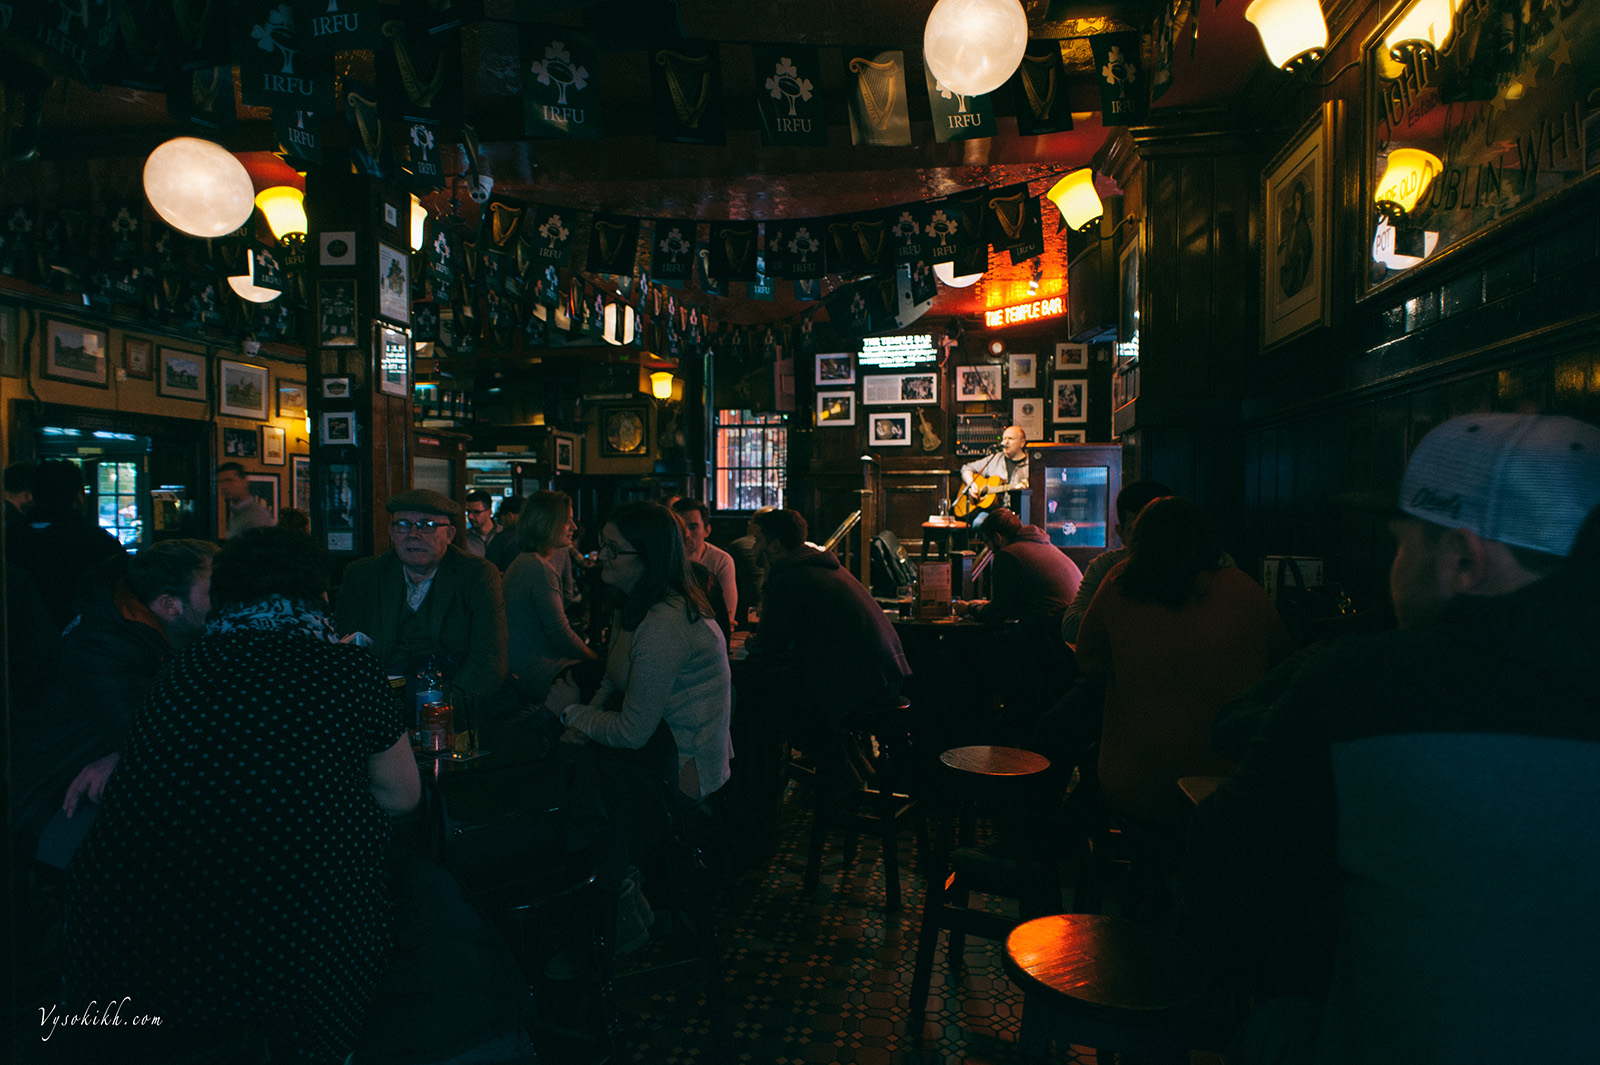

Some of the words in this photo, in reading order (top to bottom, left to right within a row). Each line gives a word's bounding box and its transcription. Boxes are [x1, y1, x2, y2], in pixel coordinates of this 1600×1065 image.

[312, 13, 359, 37] IRFU
[264, 73, 314, 96] IRFU
[1111, 100, 1136, 113] IRFU
[543, 104, 584, 124] IRFU
[777, 117, 812, 133] IRFU
[948, 113, 982, 129] IRFU
[288, 127, 315, 148] IRFU
[417, 161, 437, 176] IRFU
[1400, 170, 1417, 201] OLD
[1418, 154, 1504, 211] DUBLIN
[539, 247, 562, 259] IRFU
[899, 244, 922, 255] IRFU
[933, 244, 957, 257] IRFU
[1016, 243, 1036, 256] IRFU
[285, 254, 305, 266] IRFU
[662, 262, 685, 273] IRFU
[792, 262, 816, 273] IRFU
[261, 273, 282, 286] IRFU
[754, 285, 771, 295] IRFU
[986, 309, 1004, 327] THE
[1005, 301, 1041, 324] TEMPLE
[1041, 296, 1063, 316] BAR
